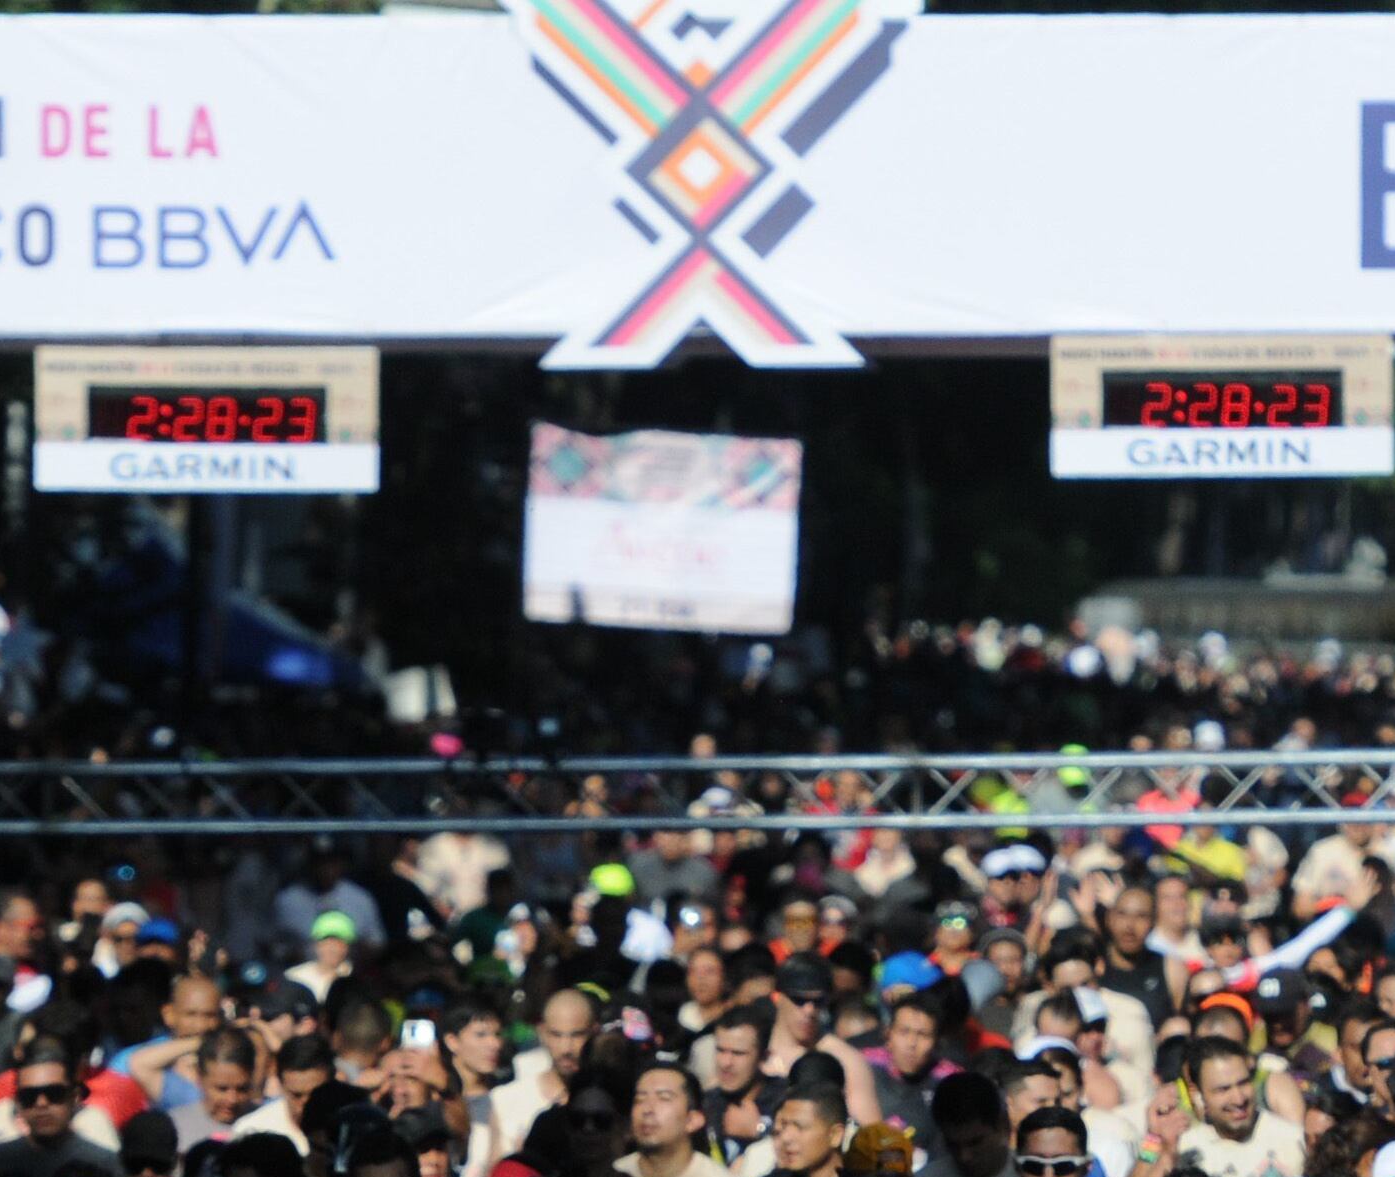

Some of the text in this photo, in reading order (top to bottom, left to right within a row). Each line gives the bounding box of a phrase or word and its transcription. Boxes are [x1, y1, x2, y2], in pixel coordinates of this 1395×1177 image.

[39, 103, 110, 158] DE
[147, 103, 219, 158] LA
[91, 199, 336, 269] BBVA
[109, 452, 296, 481] GARMIN
[1127, 438, 1311, 465] GARMIN
